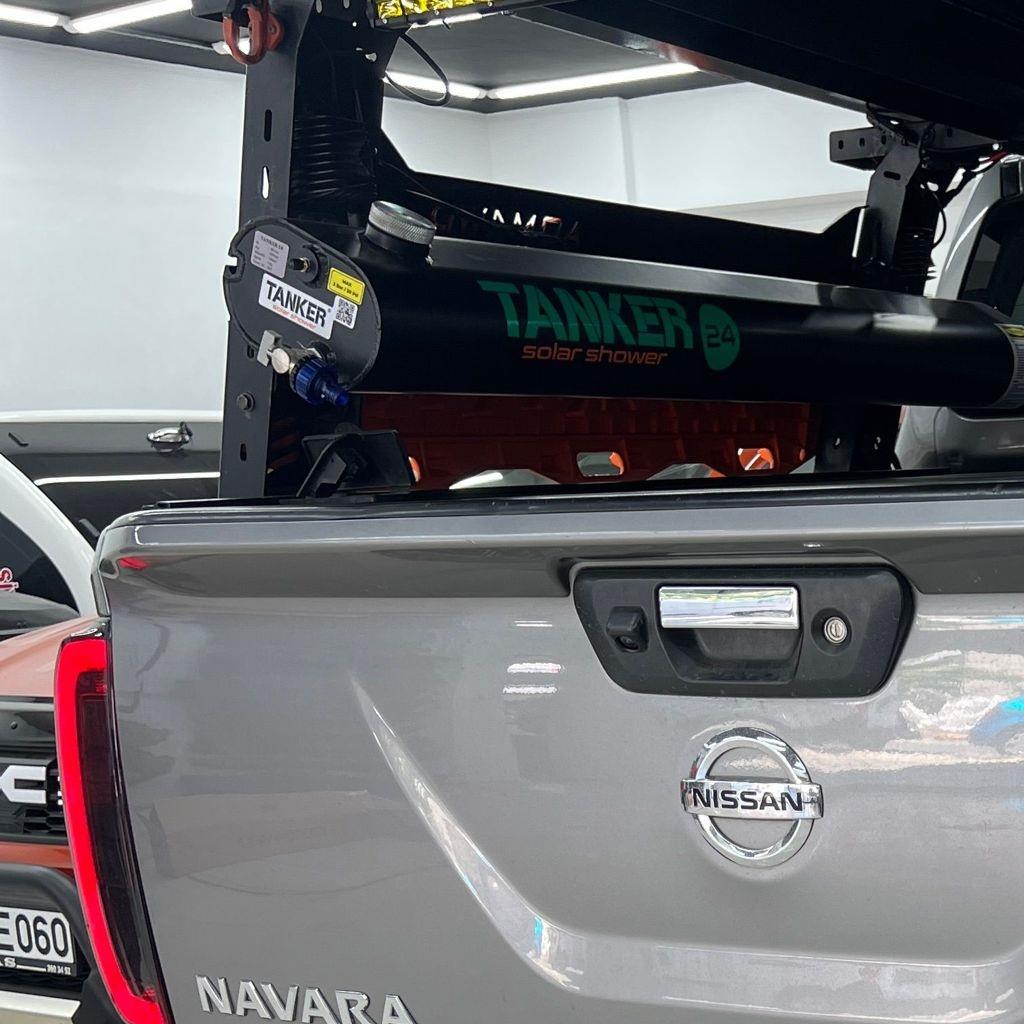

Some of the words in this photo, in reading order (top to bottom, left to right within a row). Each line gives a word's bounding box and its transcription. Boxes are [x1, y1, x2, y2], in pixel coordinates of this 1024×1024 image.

[266, 280, 327, 327] TANKER
[476, 280, 694, 350] TANKER
[704, 324, 737, 348] 24
[521, 343, 582, 361] solar
[585, 346, 668, 366] shower
[692, 787, 804, 812] NISSAN
